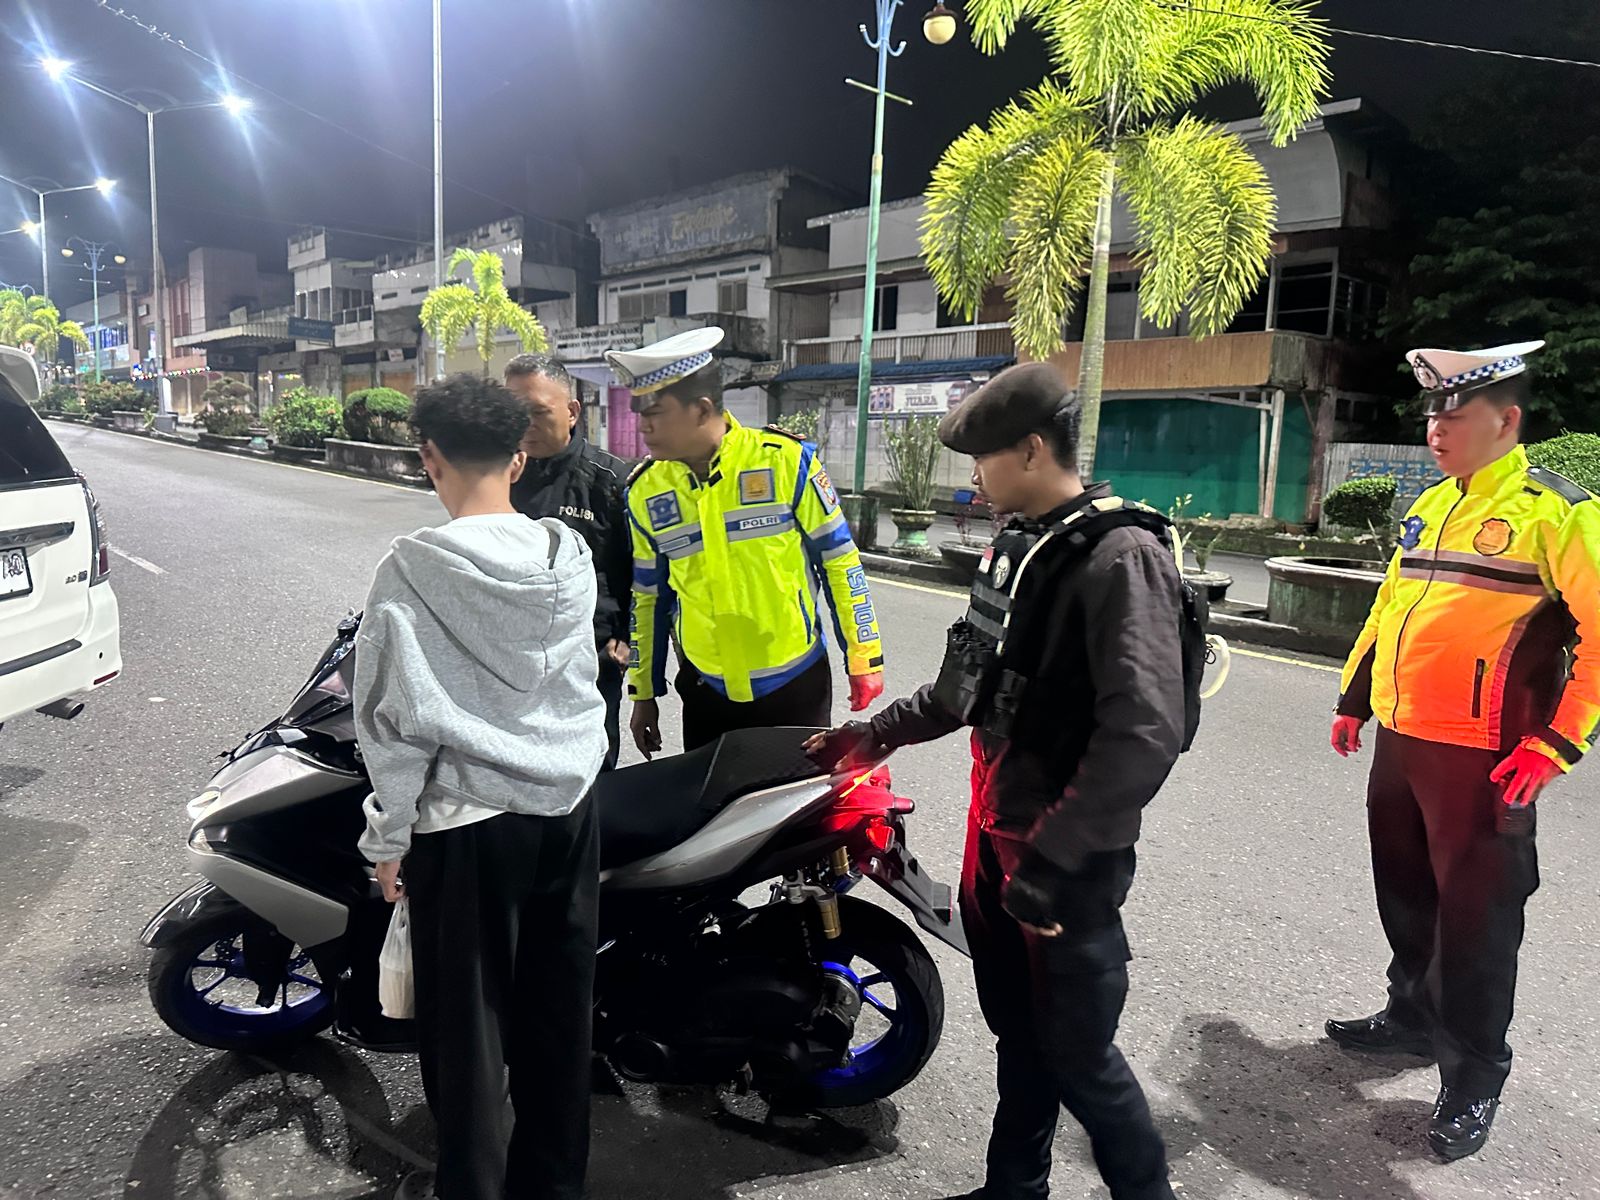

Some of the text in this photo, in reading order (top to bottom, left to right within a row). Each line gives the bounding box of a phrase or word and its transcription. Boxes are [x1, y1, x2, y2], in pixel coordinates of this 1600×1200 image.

[559, 505, 594, 521] POLISI
[742, 515, 778, 528] POLRI
[846, 563, 880, 643] POLISI
